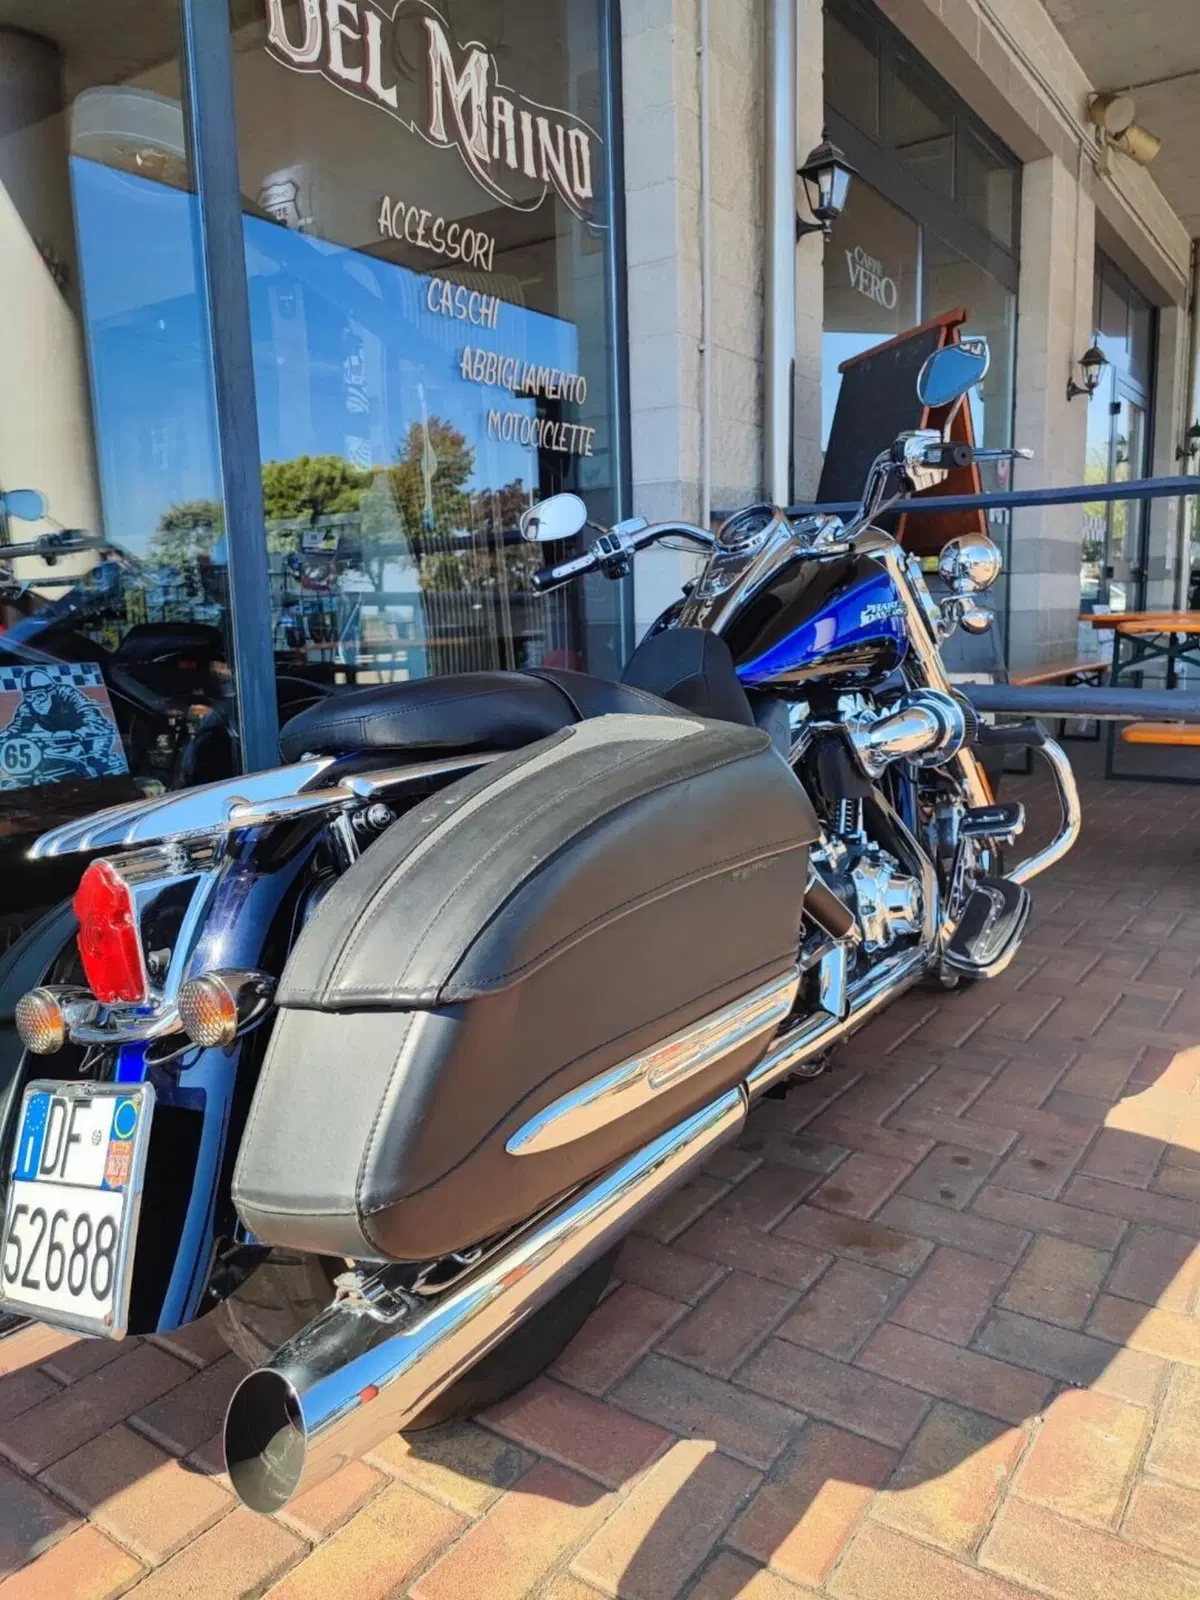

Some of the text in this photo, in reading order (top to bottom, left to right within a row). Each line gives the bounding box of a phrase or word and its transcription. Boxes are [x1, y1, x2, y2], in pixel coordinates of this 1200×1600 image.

[377, 195, 495, 272] ACCESSORI
[427, 278, 500, 330] CASCHI
[844, 249, 897, 309] VERO
[460, 345, 587, 405] ABBIGLIAMENTO
[487, 409, 596, 457] MOTOCICLETTE
[4, 743, 32, 769] 65
[39, 1096, 93, 1179] DF
[3, 1203, 119, 1302] 52688
